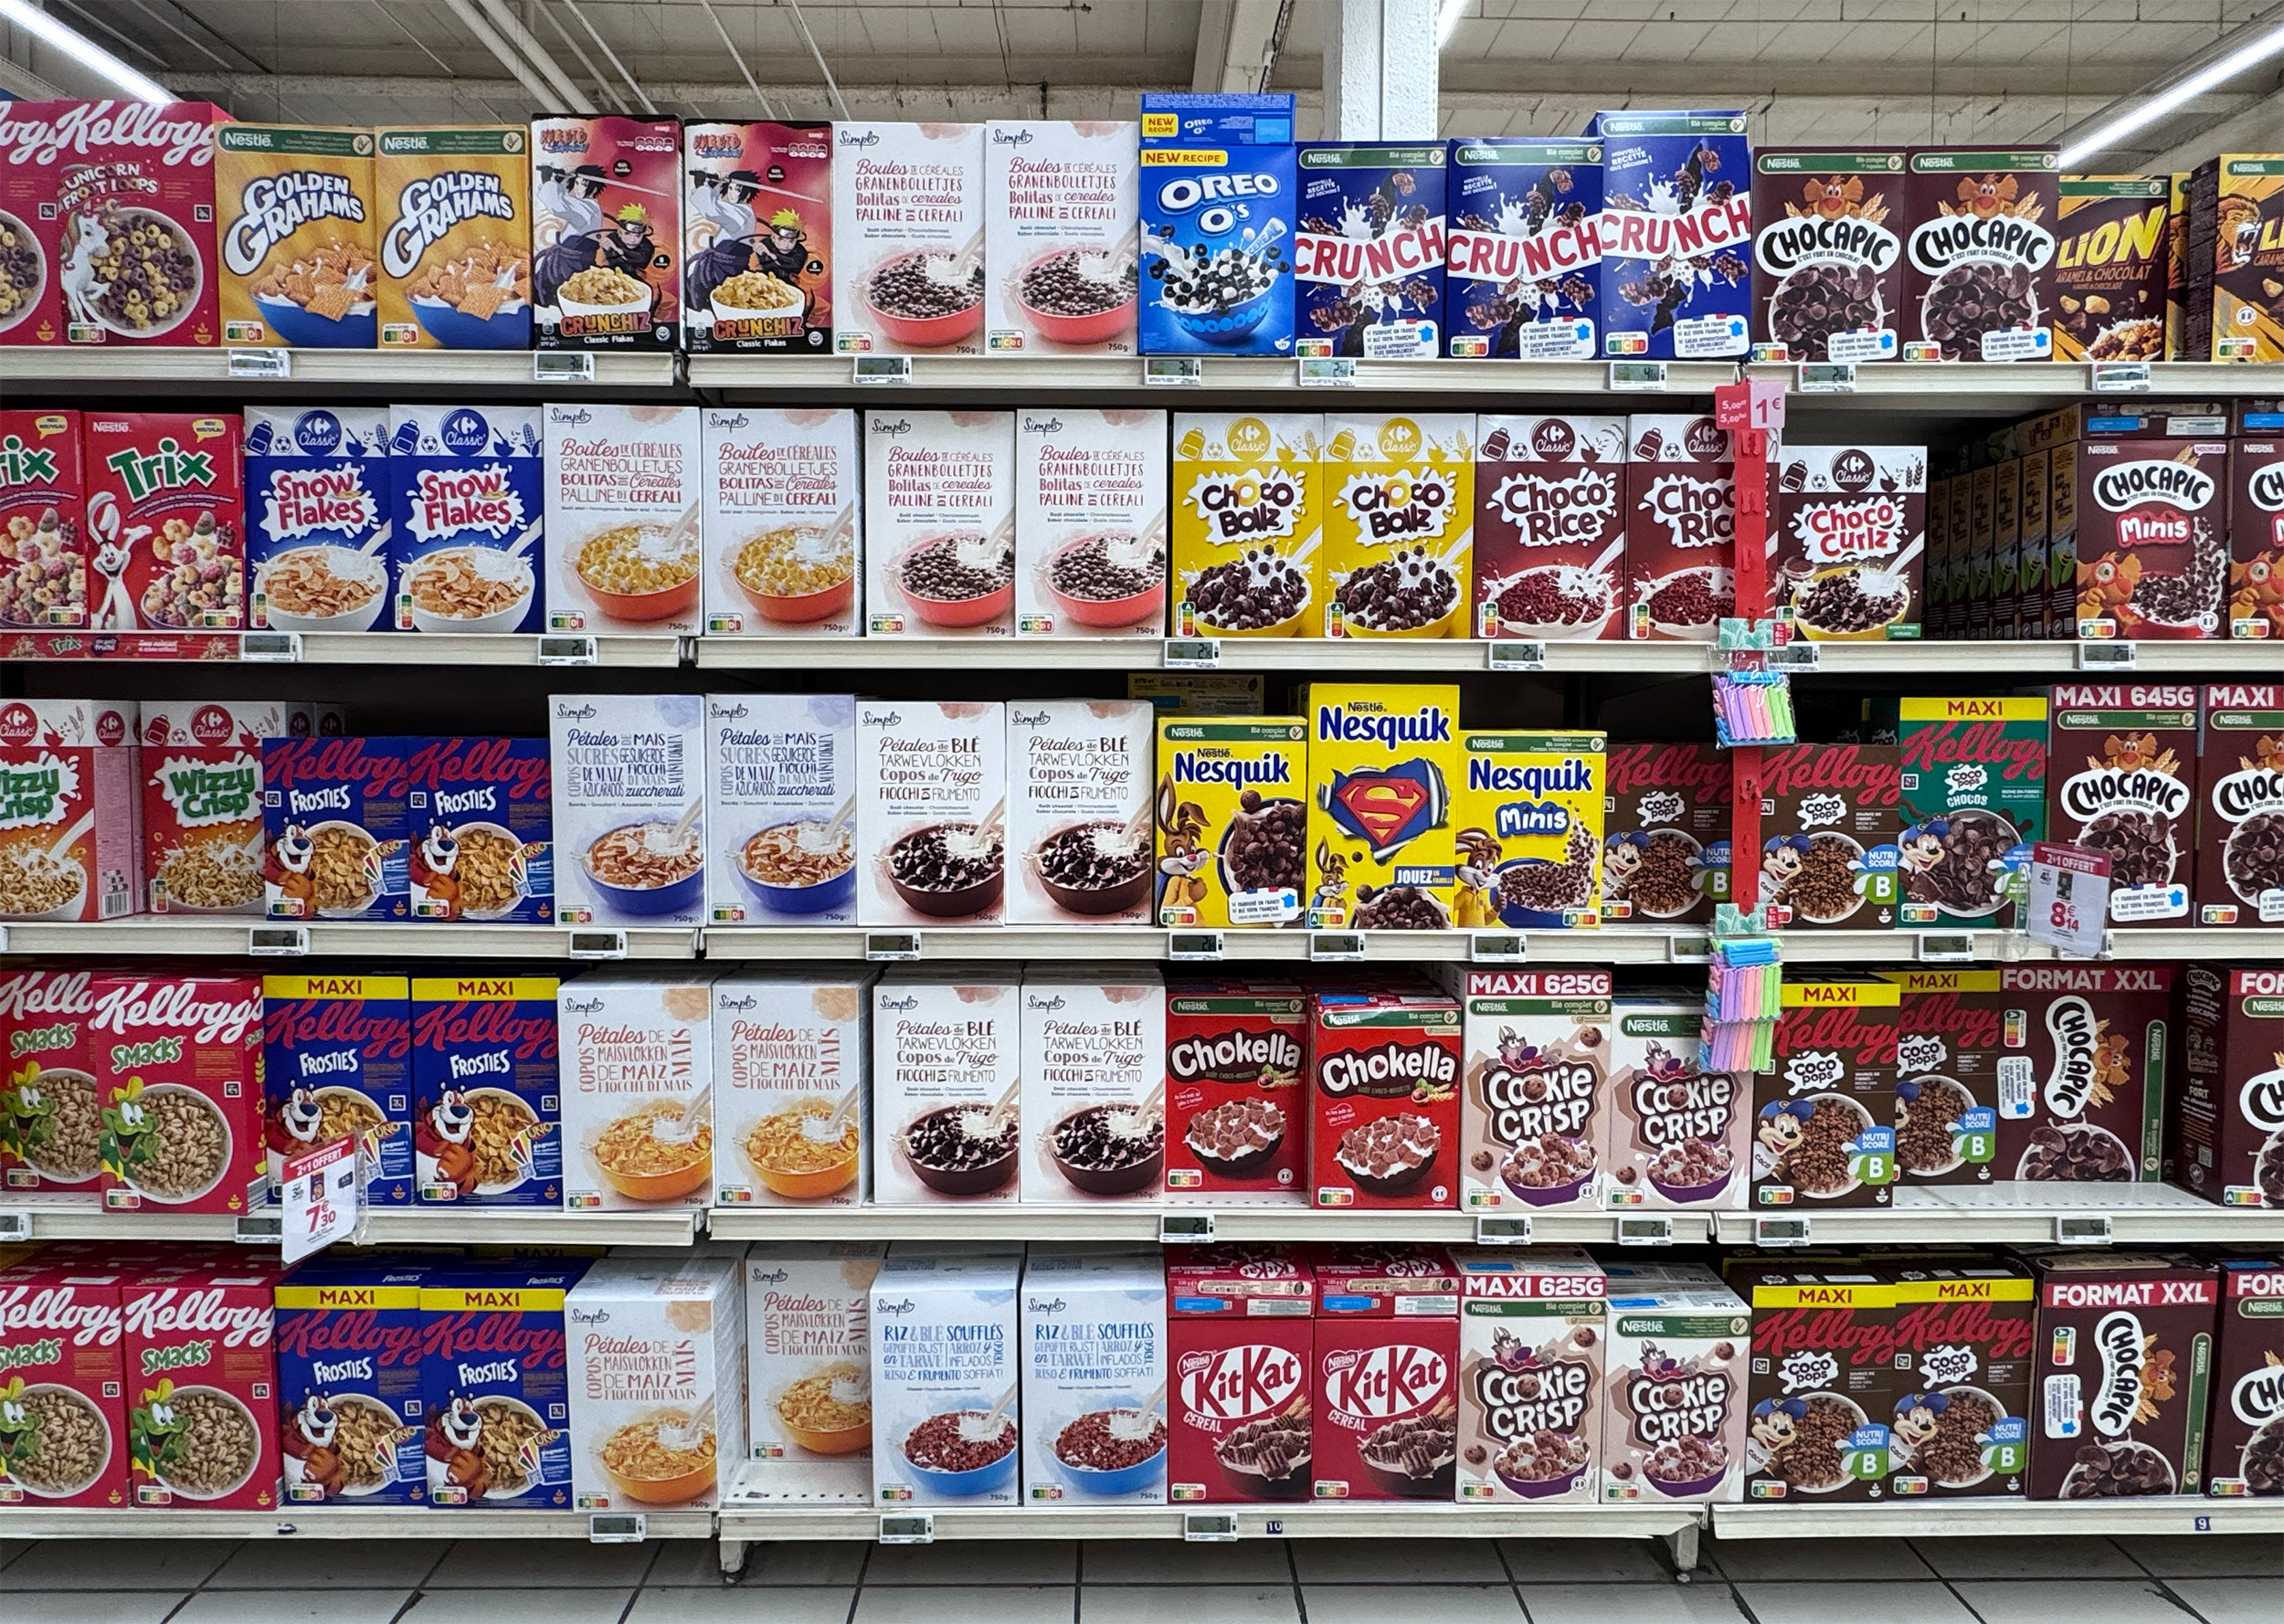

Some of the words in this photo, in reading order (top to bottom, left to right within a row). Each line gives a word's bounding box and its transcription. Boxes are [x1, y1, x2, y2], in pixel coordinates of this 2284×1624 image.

[856, 158, 909, 175] Boules
[1146, 153, 1180, 163] NEW
[1183, 154, 1221, 163] RECIPE
[856, 177, 963, 191] GRANENBOLLETJES
[1159, 174, 1280, 211] OREO
[856, 193, 899, 206] Bolitas
[856, 209, 902, 222] PALLINE
[918, 209, 963, 222] CEREALI
[223, 190, 365, 276] GRAHAMS
[380, 190, 514, 279] GRAHAMS
[1602, 199, 1750, 254] CRUNCH
[1762, 221, 1893, 269] CHOCAPIC
[1915, 220, 2046, 269] CHOCAPIC
[2057, 205, 2167, 269] LION
[1295, 224, 1444, 279] CRUNCH
[1448, 222, 1602, 276] CRUNCH
[2094, 265, 2152, 281] CHOCOLAT
[561, 314, 651, 335] CRUNCHIZ
[714, 317, 804, 338] CRUNCHIZ
[584, 335, 609, 343] Classic
[611, 335, 634, 343] Flakes
[736, 339, 763, 348] Classic
[766, 338, 787, 347] Flakes
[298, 433, 336, 448] Classic
[446, 431, 483, 446] Classic
[561, 438, 619, 457] Boules
[630, 442, 682, 458] CÉRÉALES
[1231, 439, 1265, 453] Classic
[1381, 439, 1417, 453] Classic
[1535, 438, 1571, 453] Classic
[106, 437, 217, 502] Trix
[561, 459, 682, 473] GRANENBOLLETJES
[1039, 463, 1143, 477] GRANENBOLLETJES
[561, 475, 617, 486] BOLITAS
[1835, 469, 1870, 484] Classic
[2099, 466, 2210, 506] CHOCAPIC
[276, 472, 354, 501] Snow
[423, 472, 502, 501] Snow
[561, 489, 616, 502] PALLINE
[629, 490, 681, 502] CEREALI
[1040, 494, 1084, 506] PALLINE
[1100, 494, 1143, 506] CEREALI
[1504, 481, 1607, 514] Choco
[278, 498, 365, 530] Flakes
[425, 499, 511, 530] Flakes
[1811, 504, 1893, 533] Choco
[1526, 509, 1597, 543] Rice
[2120, 517, 2187, 543] Minis
[1821, 531, 1888, 556] Curlz
[1348, 701, 1387, 712] Nestlé
[2056, 687, 2120, 706] MAXI
[2131, 687, 2194, 707] 645G
[1948, 701, 2003, 716] MAXI
[196, 726, 228, 737] Classic
[567, 729, 619, 746] Pétales
[1320, 707, 1450, 749] Nesquik
[879, 736, 936, 753] Pétales
[951, 735, 980, 753] BLÉ
[1197, 748, 1233, 757] Nestlé
[1472, 739, 1504, 748] Nestlé
[567, 745, 619, 765] SUCRÉS
[879, 754, 981, 767] TARWEVLOKKEN
[628, 764, 666, 775] FIOCCHI
[880, 768, 925, 784] Copos
[941, 767, 984, 786] Trigo
[1176, 753, 1290, 790] Nesquik
[1470, 758, 1592, 798] Nesquik
[169, 767, 255, 796] Wizzy
[626, 784, 684, 797] zuccherati
[290, 785, 351, 815] FROSTIES
[435, 786, 496, 816] FROSTIES
[880, 787, 919, 800] FIOCCHI
[933, 788, 980, 801] FRUMENTO
[1947, 796, 1988, 807] CHOCOS
[2067, 774, 2183, 816] CHOCAPIC
[183, 793, 248, 818] Crisp
[1812, 807, 1838, 820] pops
[1500, 807, 1567, 832] Minis
[1868, 851, 1898, 860] NUTRI
[1868, 859, 1898, 868] SCORE
[2062, 857, 2095, 873] OFFERT
[1396, 870, 1433, 884] JOUEZ
[1876, 876, 1891, 897] B
[2050, 902, 2067, 928] 8
[2067, 917, 2079, 932] 14
[308, 980, 363, 995] MAXI
[1471, 975, 1537, 994] MAXI
[1545, 975, 1609, 993] 625G
[2003, 969, 2105, 990] FORMAT
[2115, 970, 2162, 990] XXL
[1803, 987, 1856, 1002] MAXI
[95, 983, 263, 1043] Kellogg's
[578, 1023, 646, 1045] Pétales
[649, 1029, 664, 1043] DE
[1627, 1018, 1670, 1032] Nestlé
[299, 1049, 358, 1077] FROSTIES
[1171, 1032, 1301, 1077] Chokella
[2053, 1002, 2091, 1111] CHOCAPIC
[597, 1065, 618, 1081] DE
[622, 1062, 667, 1080] MAÍZ
[1322, 1045, 1456, 1091] Chokella
[1803, 1071, 1834, 1086] pops
[312, 1147, 344, 1169] OFFERT
[306, 1205, 321, 1233] 7
[321, 1210, 336, 1226] 30
[1465, 1277, 1531, 1296] MAXI
[1539, 1277, 1603, 1296] 625G
[1798, 1289, 1852, 1303] MAXI
[2053, 1285, 2154, 1306] FORMAT
[2162, 1283, 2208, 1303] XXL
[320, 1290, 375, 1304] MAXI
[465, 1292, 520, 1306] MAXI
[884, 1326, 907, 1341] RIZ
[946, 1323, 1003, 1341] SOUFFLÉS
[1622, 1321, 1665, 1333] Nestlé
[584, 1334, 650, 1355] Pétales
[949, 1342, 981, 1354] ARROZ
[899, 1355, 944, 1367] TARWE
[949, 1355, 991, 1366] INFLADOS
[313, 1357, 373, 1385] FROSTIES
[458, 1359, 518, 1387] FROSTIES
[586, 1357, 603, 1399] COPOS
[918, 1370, 961, 1381] FRUMENTO
[2099, 1317, 2139, 1429] CHOCAPIC
[1195, 1347, 1296, 1416] KitKat
[1339, 1347, 1441, 1416] KitKat
[1183, 1411, 1222, 1432] CEREAL
[1327, 1409, 1366, 1431] CEREAL
[1856, 1429, 1884, 1439] NUTRI
[1856, 1437, 1883, 1446] SCORE
[1862, 1453, 1877, 1473] B
[1267, 1522, 1282, 1531] 10
[2198, 1518, 2207, 1529] 9
